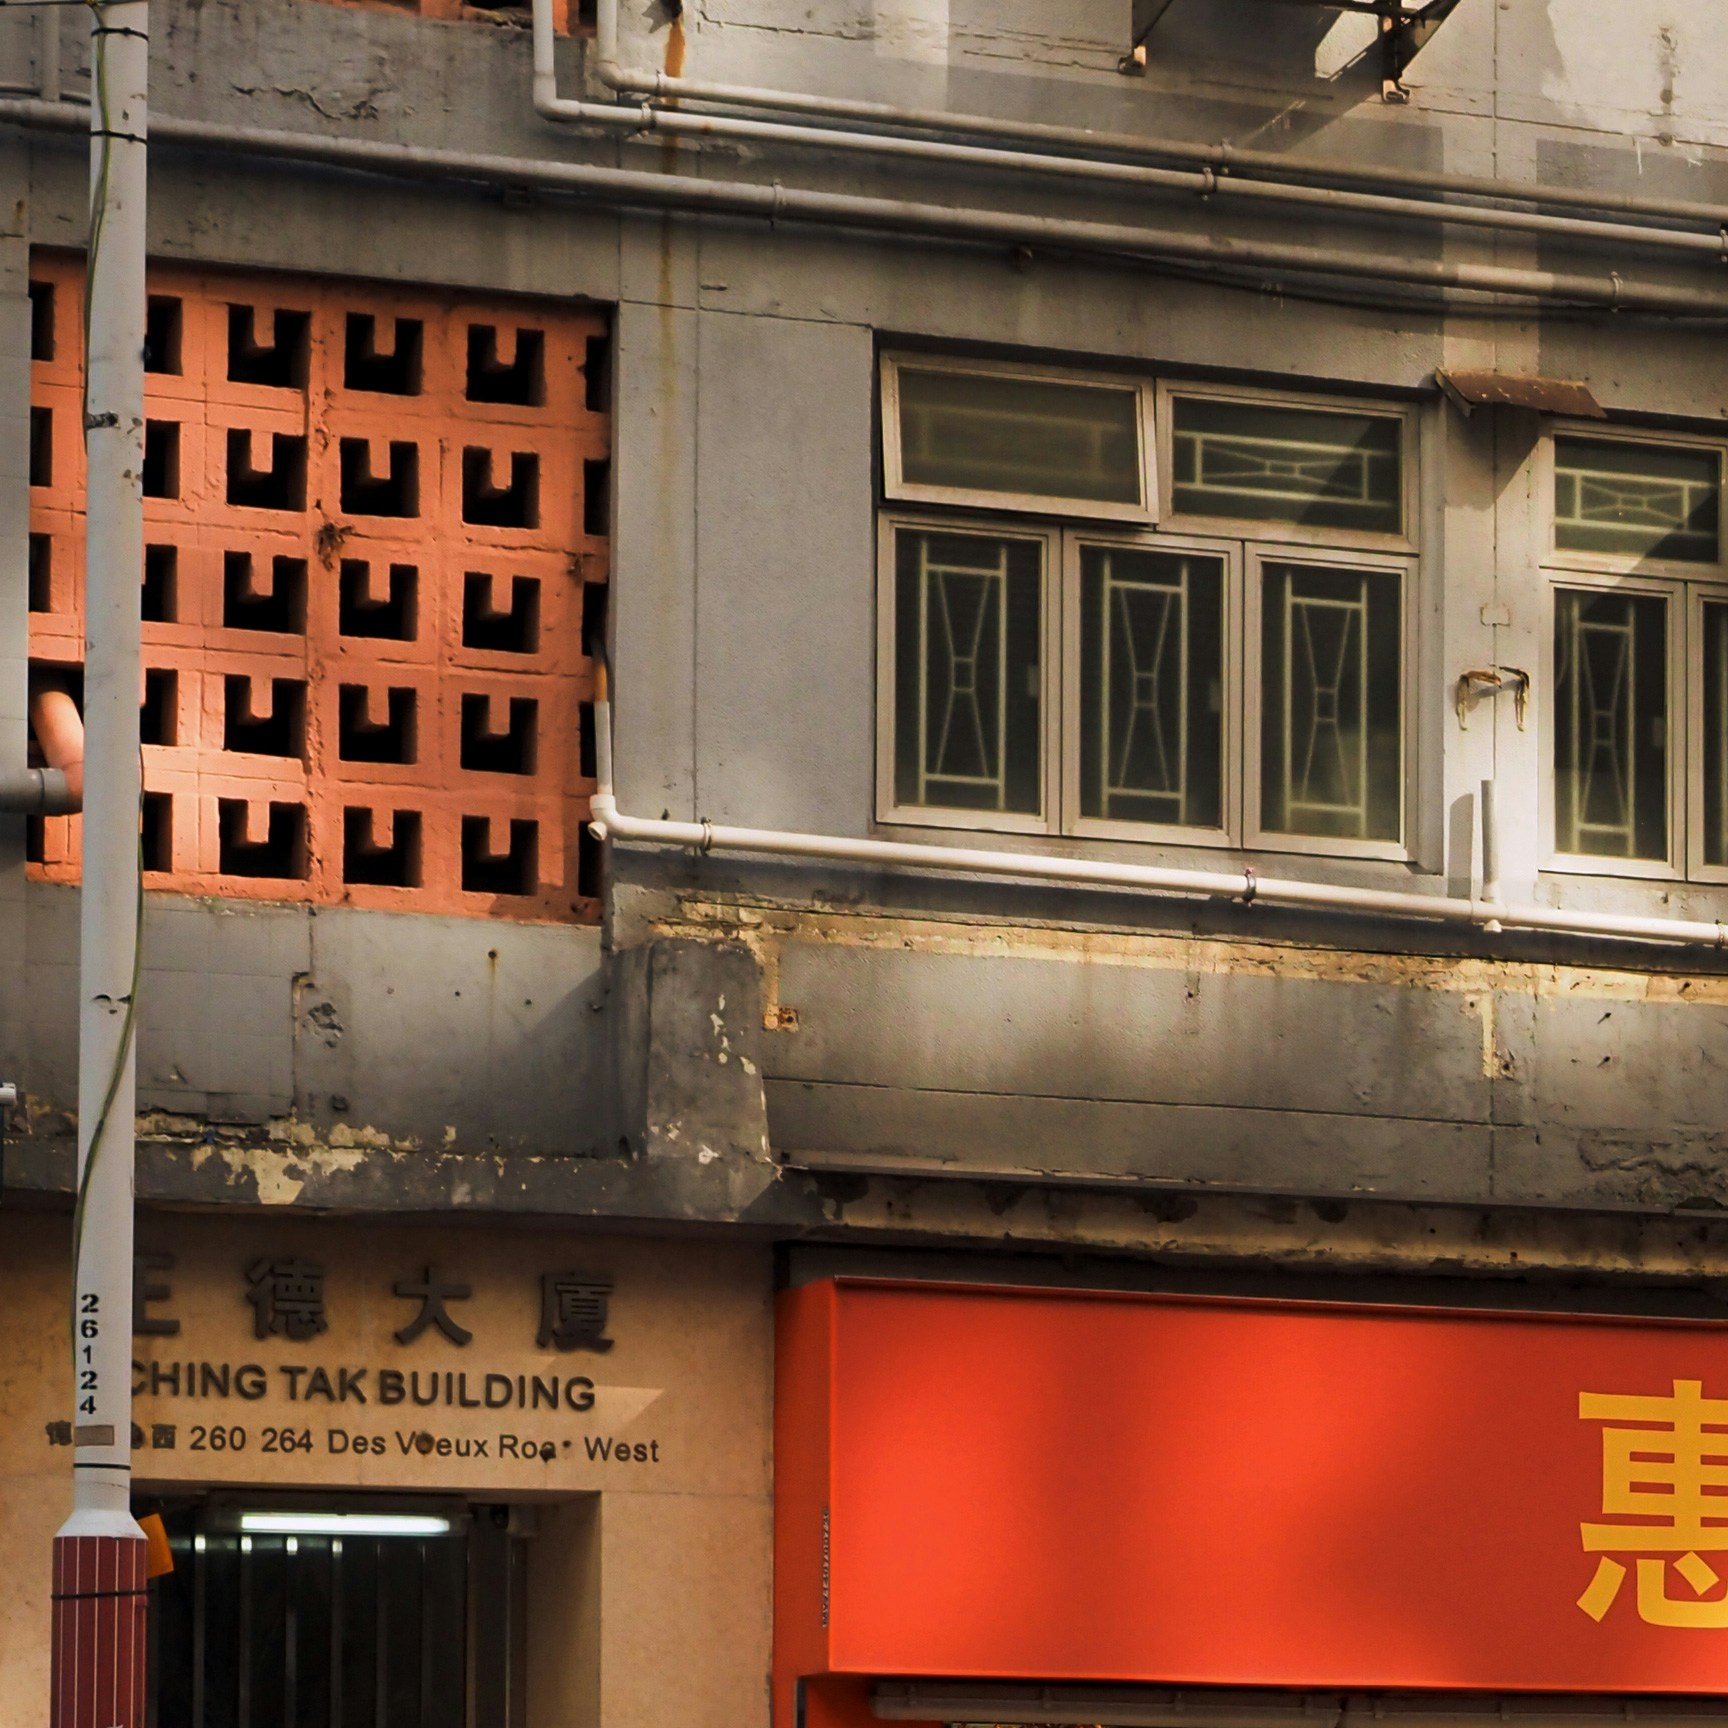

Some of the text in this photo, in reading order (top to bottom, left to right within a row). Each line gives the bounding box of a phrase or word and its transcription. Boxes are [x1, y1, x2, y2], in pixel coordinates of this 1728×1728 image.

[80, 1293, 100, 1415] 26124
[130, 1359, 597, 1412] CHING TAK BUILDING
[189, 1425, 247, 1451] 260
[261, 1428, 314, 1453] 264
[327, 1428, 387, 1455] Des
[499, 1434, 572, 1463] Roa
[584, 1435, 660, 1463] West
